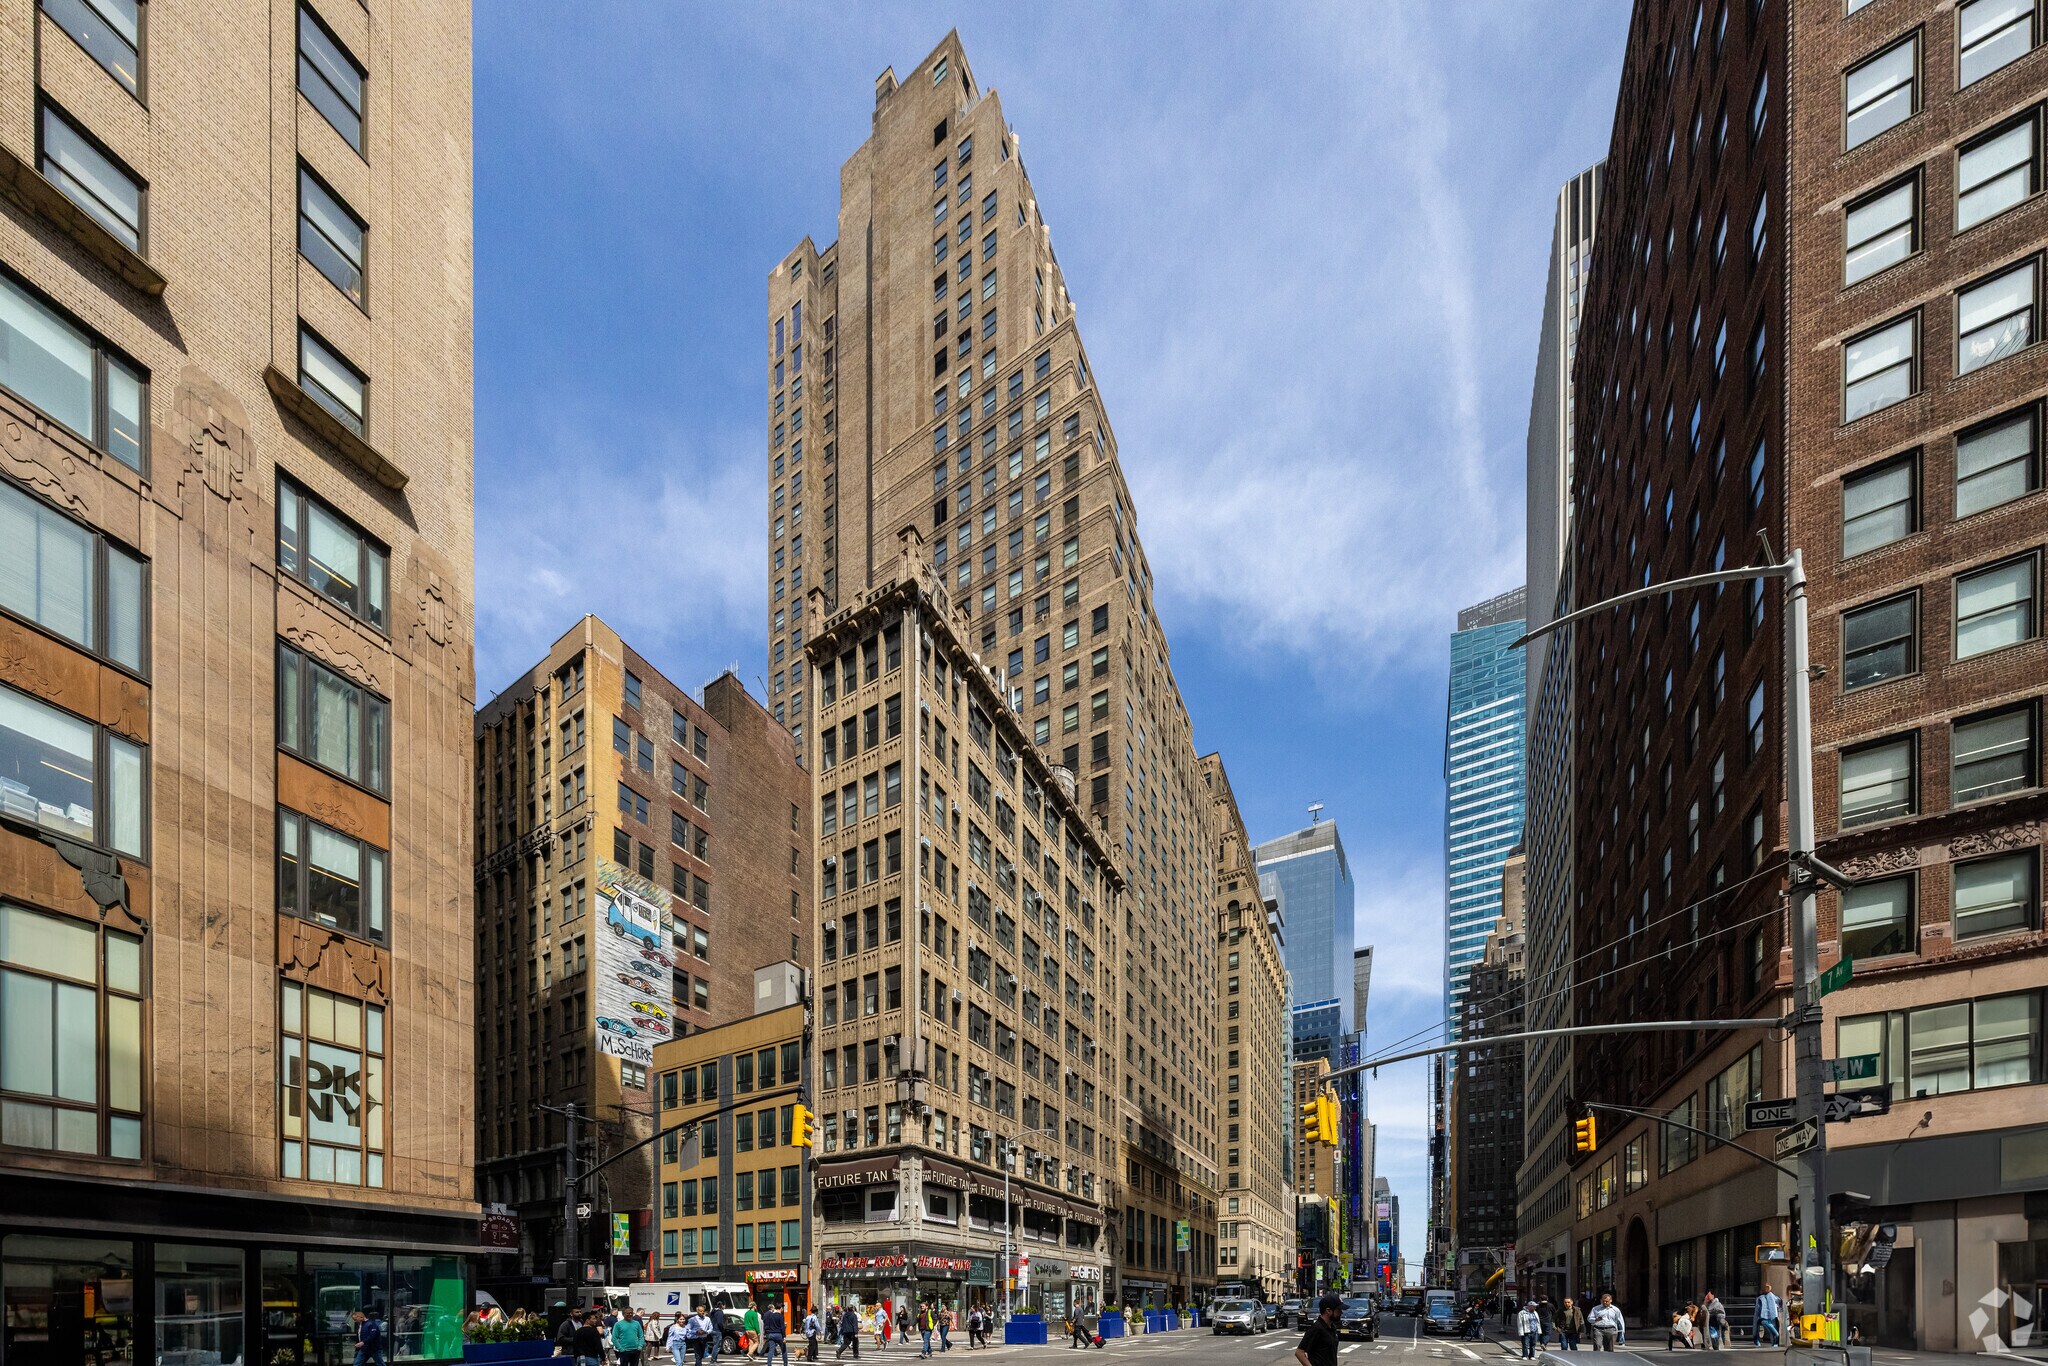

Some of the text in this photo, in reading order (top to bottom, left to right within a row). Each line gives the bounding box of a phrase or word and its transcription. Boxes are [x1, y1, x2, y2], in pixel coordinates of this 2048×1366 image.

[1827, 971, 1833, 989] 7
[1850, 1059, 1864, 1076] W
[289, 1055, 377, 1102] DK
[1755, 1101, 1850, 1121] ONE AY
[1777, 1128, 1812, 1153] ONE WAY
[817, 1172, 862, 1188] FUTURE
[866, 1170, 888, 1182] TAN
[932, 1170, 971, 1190] FUTURE TAN
[980, 1184, 1024, 1204] FUTUR TAN
[1033, 1199, 1068, 1217] FUTURE TAN
[1074, 1211, 1093, 1223] FUTURE
[487, 1215, 518, 1234] BROADWAY
[820, 1254, 905, 1270] HEALTH KING
[916, 1255, 971, 1271] HEALTH KING
[755, 1269, 797, 1279] INDICA
[971, 1269, 988, 1278] SATIVA
[1078, 1265, 1100, 1280] GIFTS
